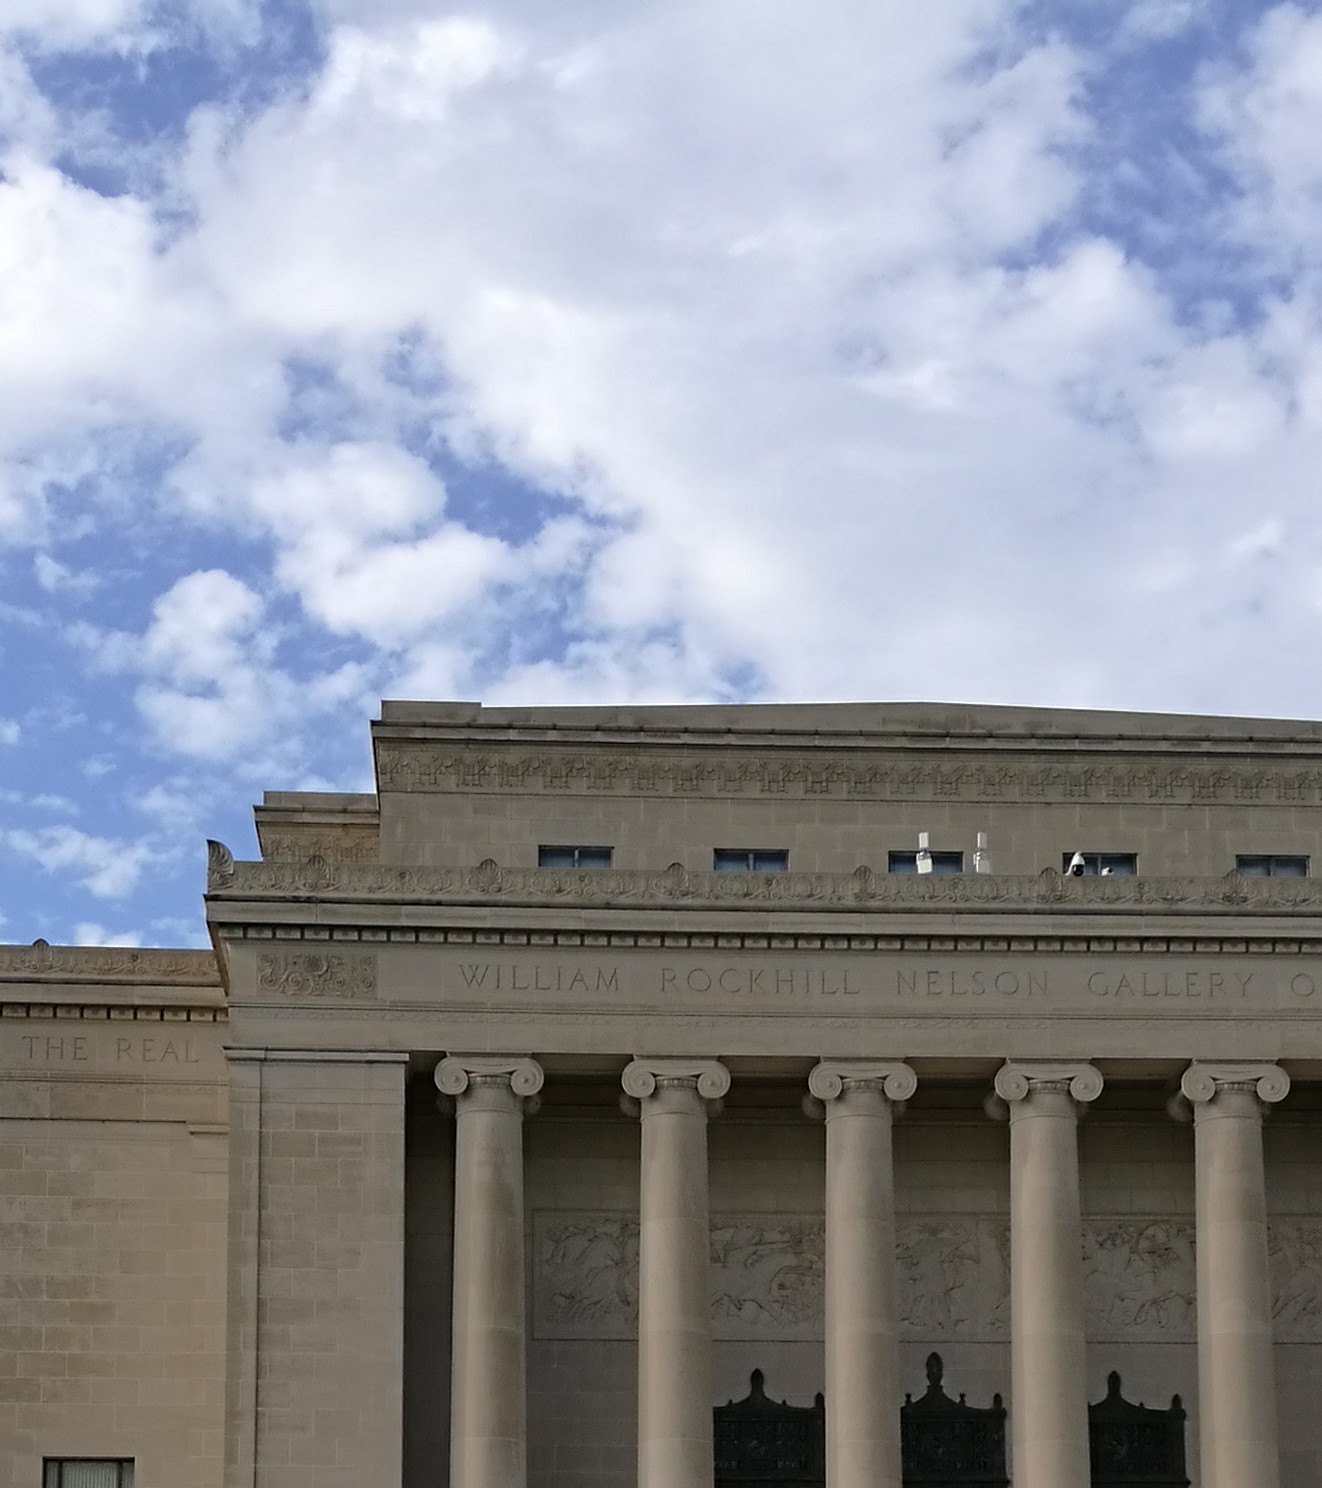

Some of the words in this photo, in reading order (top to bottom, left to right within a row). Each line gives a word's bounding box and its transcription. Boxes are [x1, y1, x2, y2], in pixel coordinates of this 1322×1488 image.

[457, 963, 619, 992] WILLIAM
[660, 966, 861, 996] ROCKHILL
[895, 968, 1051, 997] NELSON
[1086, 970, 1256, 999] GALLERY
[21, 1035, 89, 1061] THE
[115, 1037, 202, 1064] REAL
